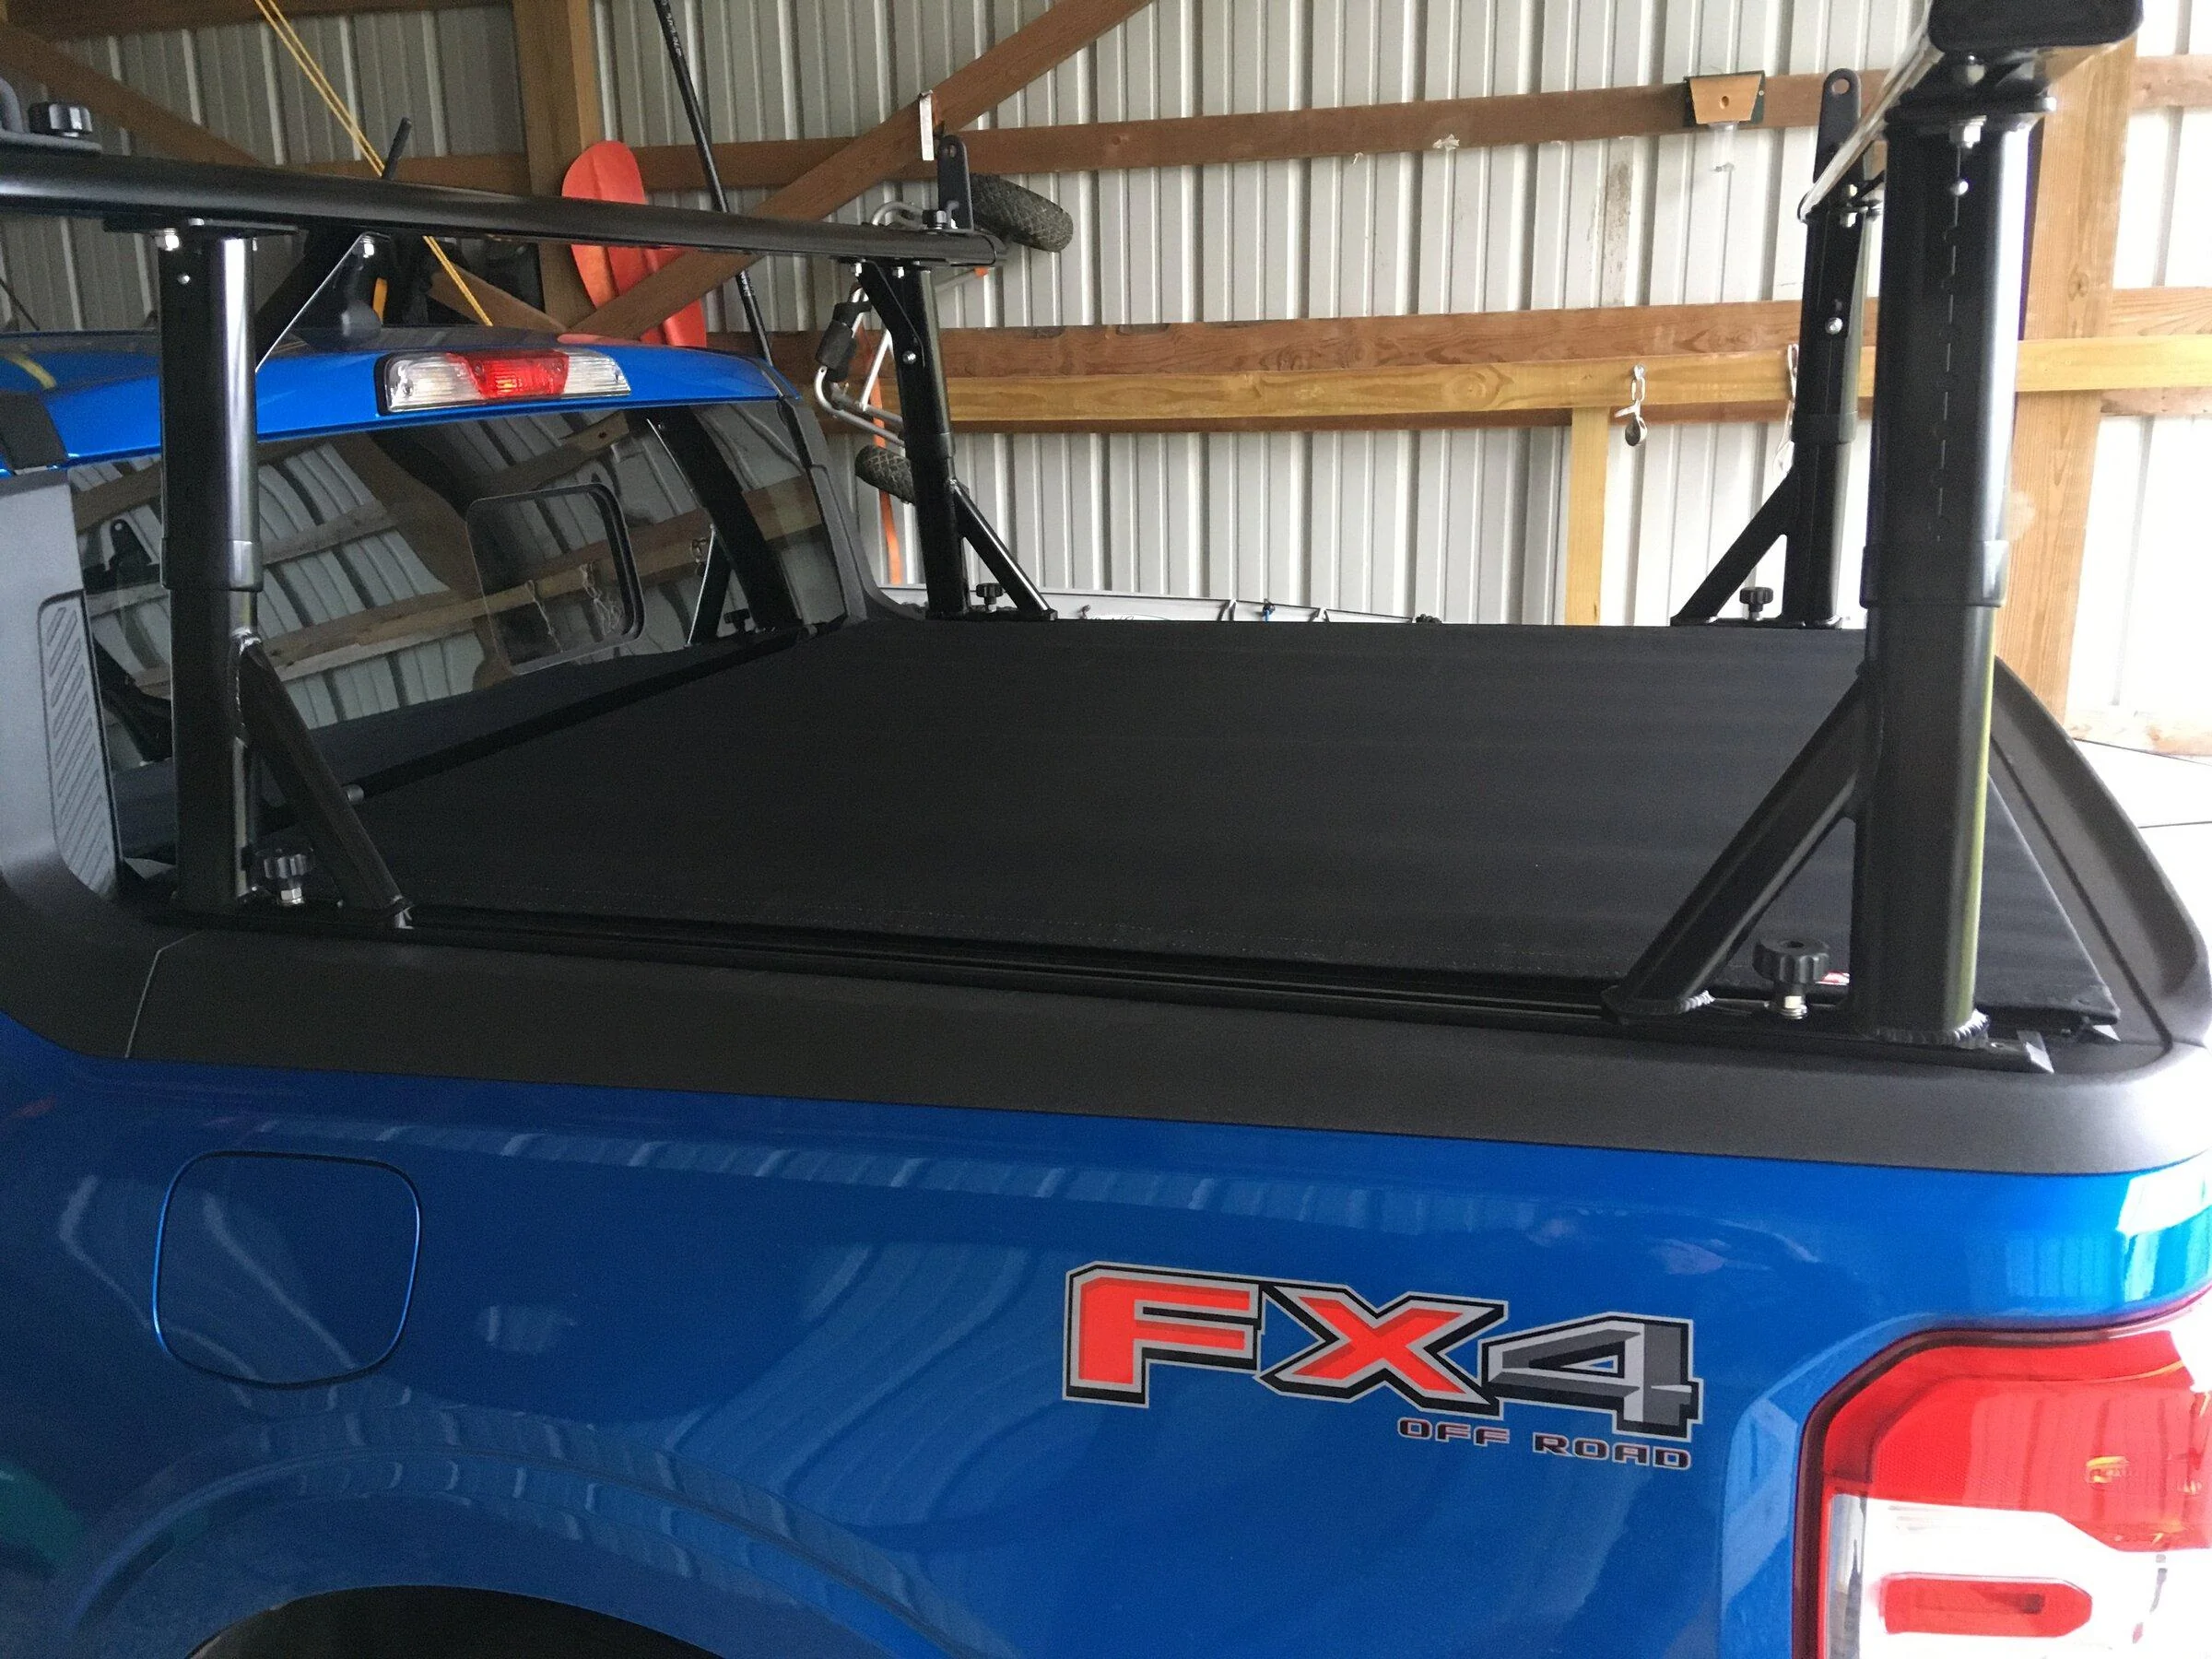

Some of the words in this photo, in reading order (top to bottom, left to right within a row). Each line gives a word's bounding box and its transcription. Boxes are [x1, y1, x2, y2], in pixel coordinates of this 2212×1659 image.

[1063, 1262, 1702, 1440] FX4
[1397, 1417, 1510, 1447] OFF
[1533, 1432, 1691, 1470] ROAD
